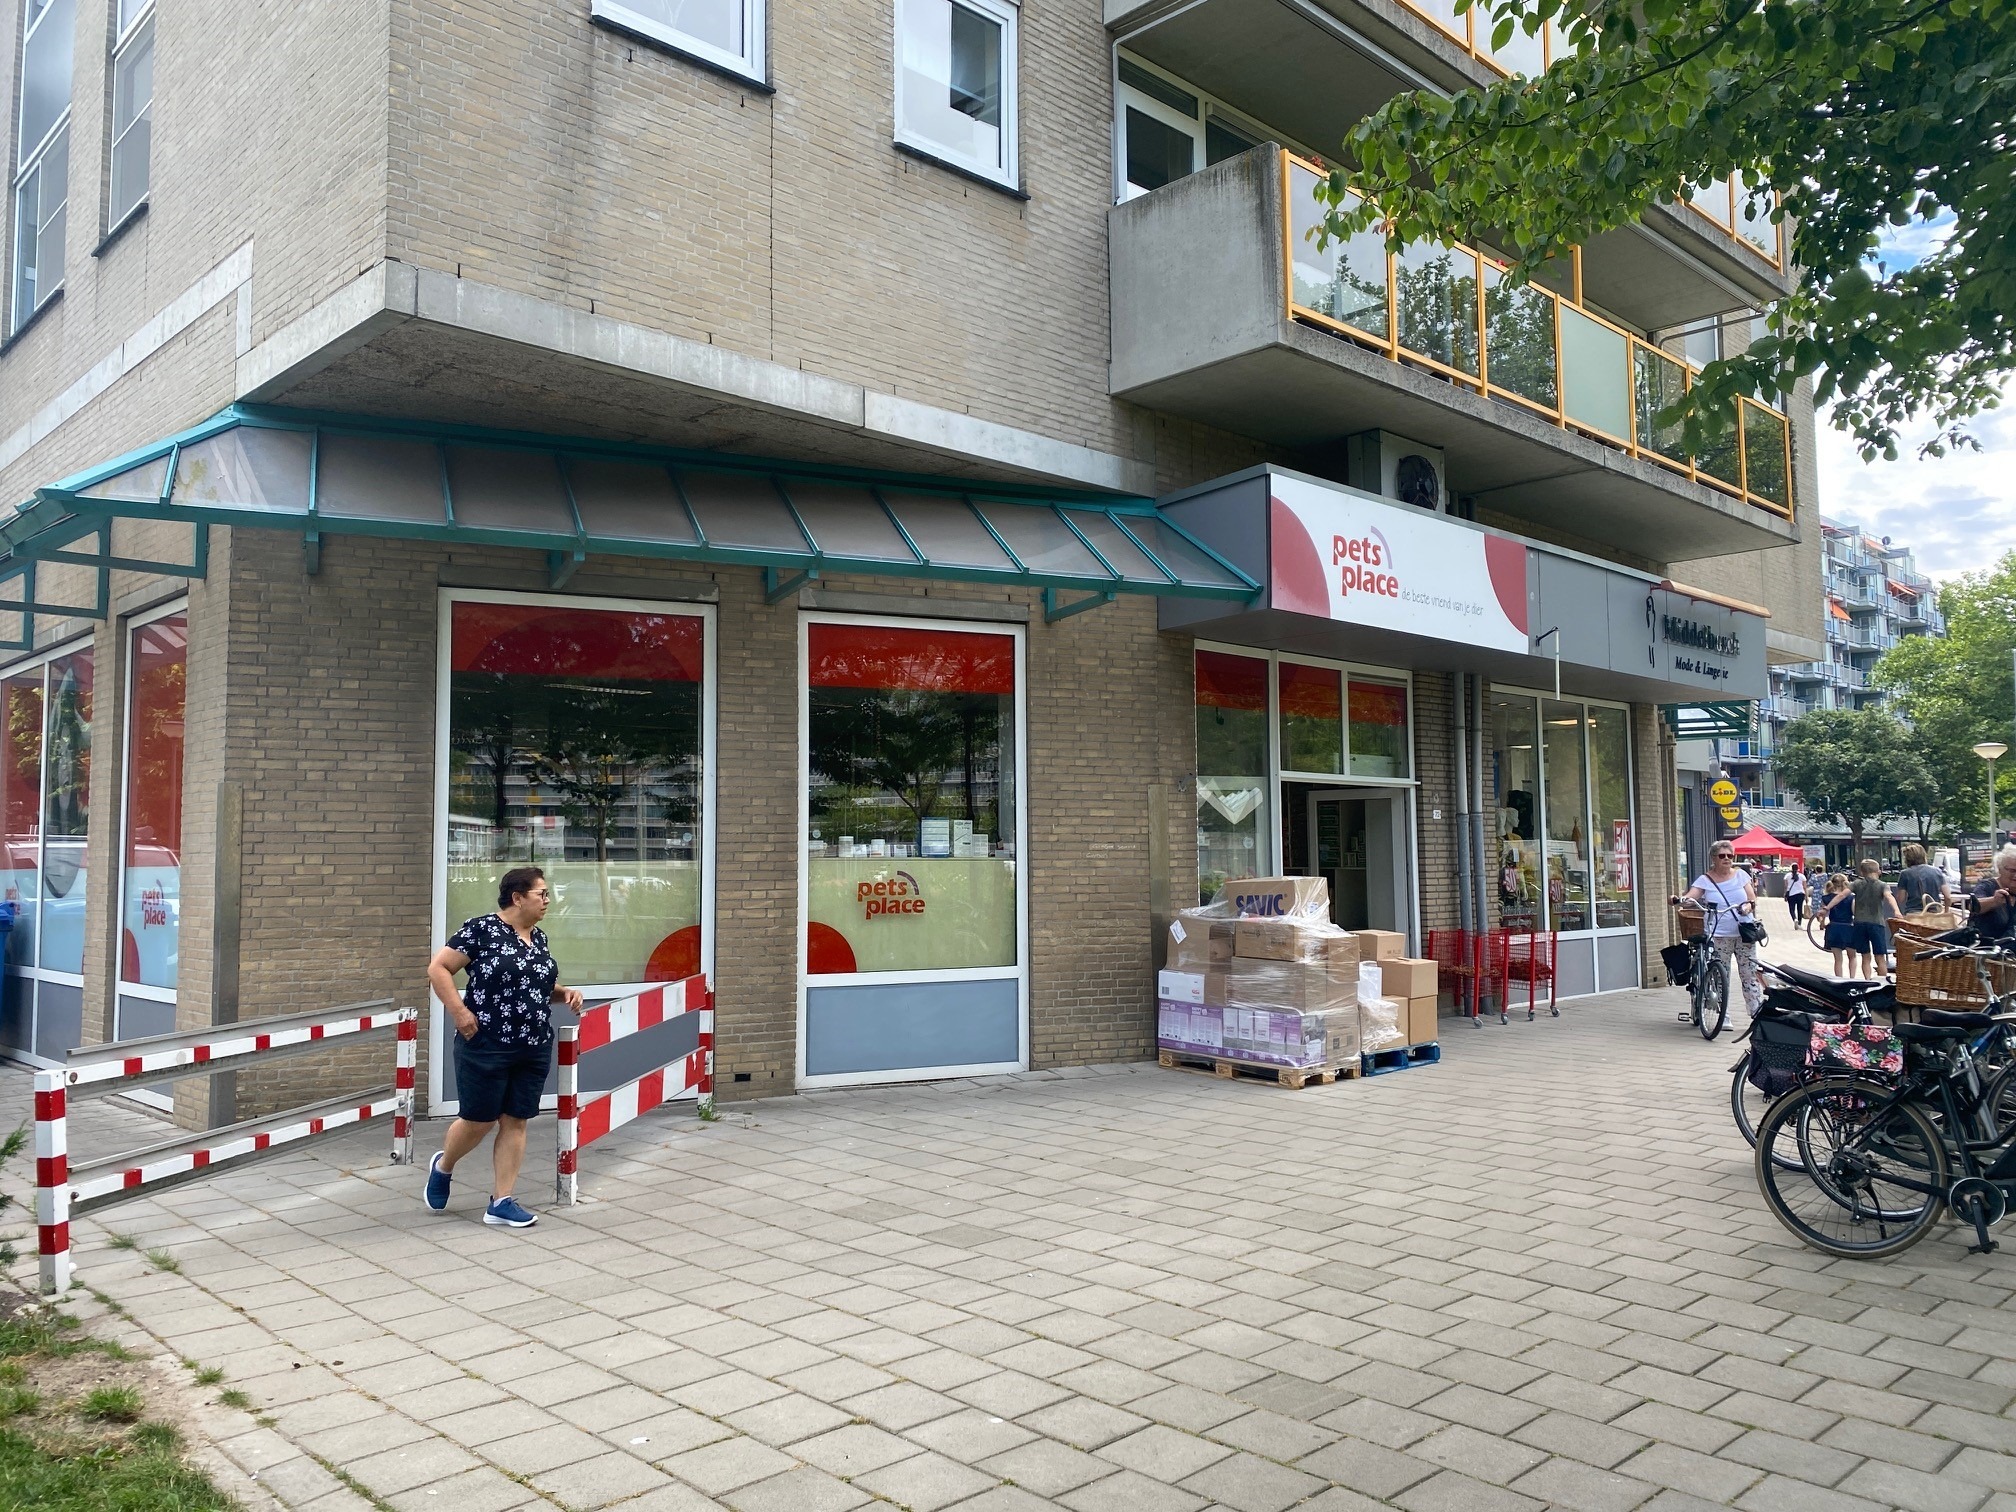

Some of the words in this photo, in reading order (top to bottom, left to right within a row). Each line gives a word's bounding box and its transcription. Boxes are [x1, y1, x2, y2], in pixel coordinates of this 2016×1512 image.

[1333, 535, 1381, 566] pets
[1342, 565, 1399, 597] place
[1402, 588, 1411, 600] de
[1412, 590, 1430, 605] beste
[1431, 597, 1451, 610] vriend
[1452, 602, 1463, 612] van
[1464, 602, 1471, 616] je
[1471, 604, 1483, 616] dier
[1675, 656, 1693, 671] Mode
[1695, 661, 1701, 673] &
[1703, 662, 1728, 680] Lingeie
[1712, 788, 1735, 796] LIDL
[142, 889, 160, 910] pets
[858, 879, 907, 902] pets
[866, 898, 926, 920] place
[1236, 894, 1284, 916] SAVIC
[144, 907, 165, 929] place
